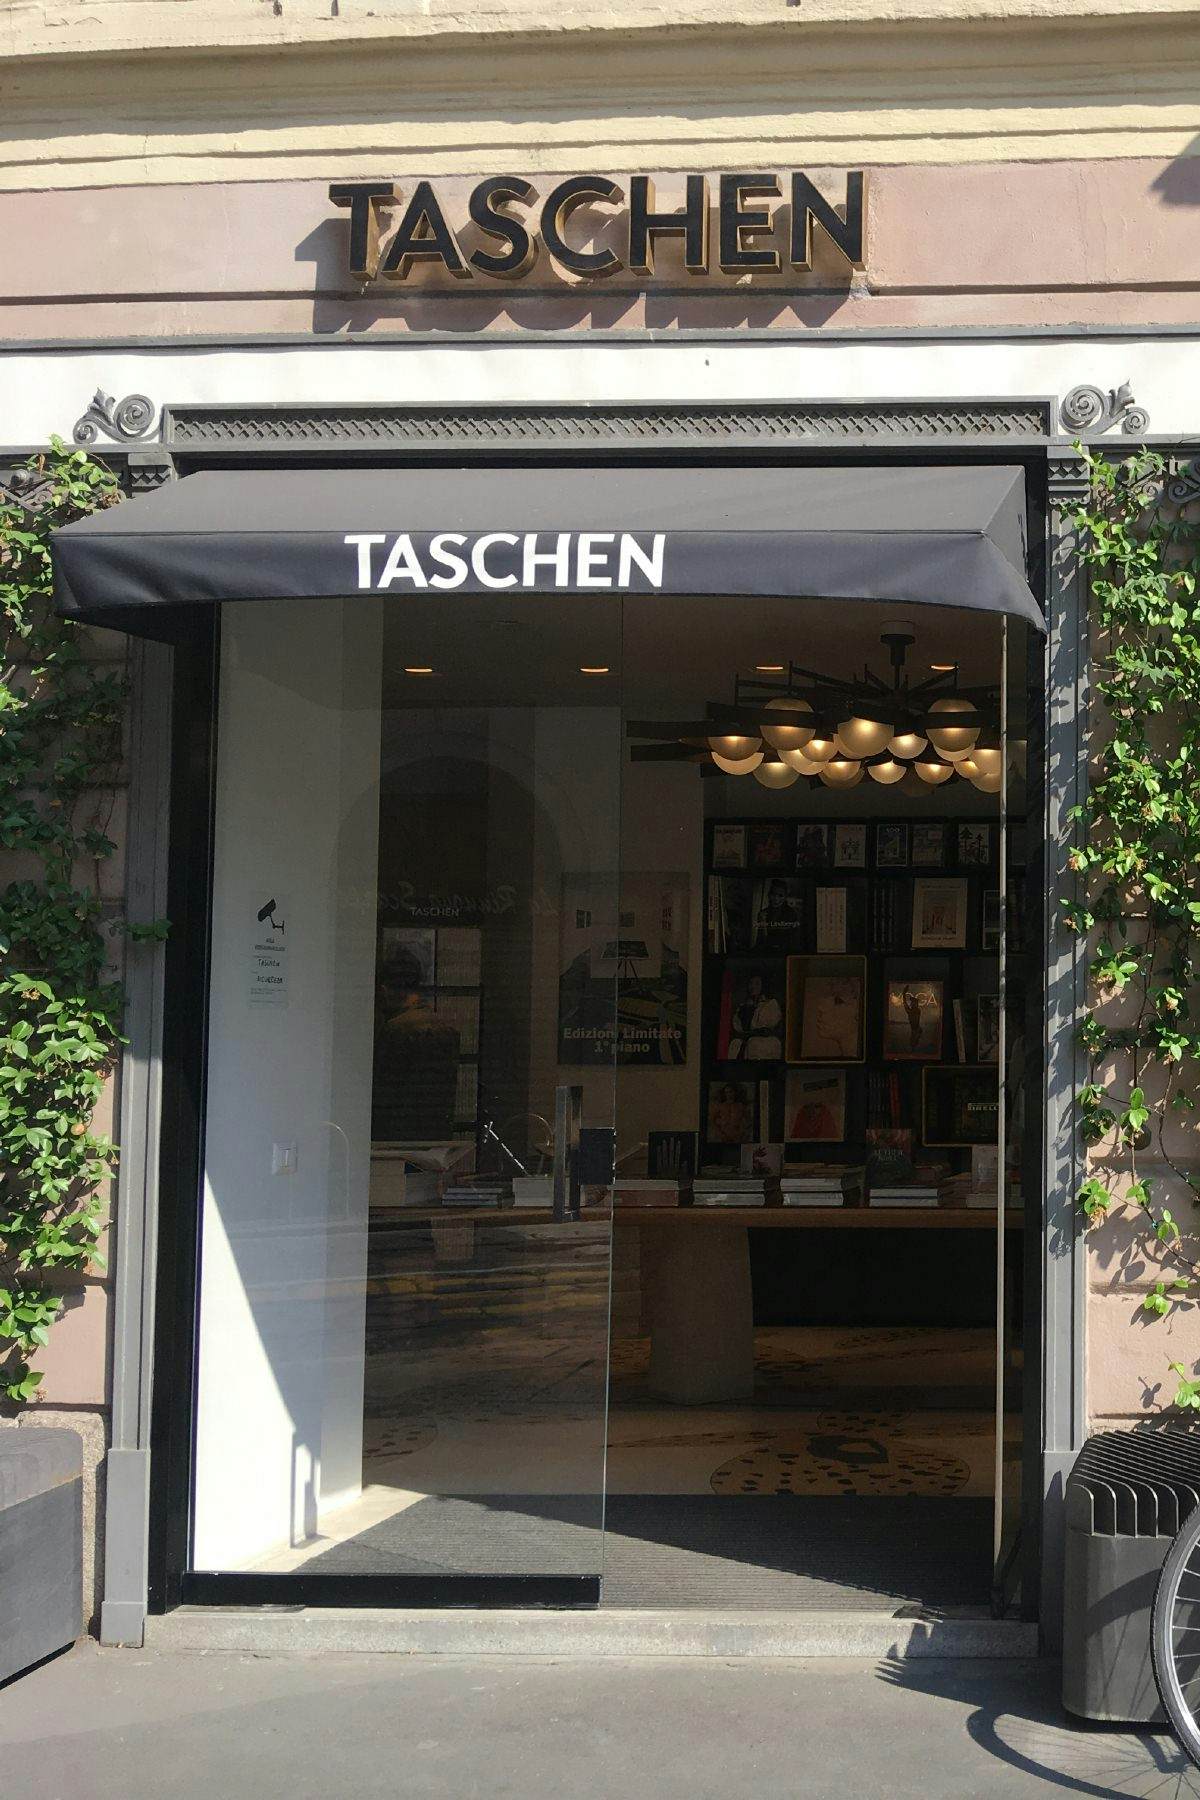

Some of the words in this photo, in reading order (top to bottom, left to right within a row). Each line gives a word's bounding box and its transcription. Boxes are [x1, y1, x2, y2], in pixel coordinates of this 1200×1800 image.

[329, 171, 869, 281] TASCHEN
[344, 532, 666, 590] TASCHEN
[408, 906, 459, 917] TASCHEN
[623, 1027, 683, 1040] Limitate
